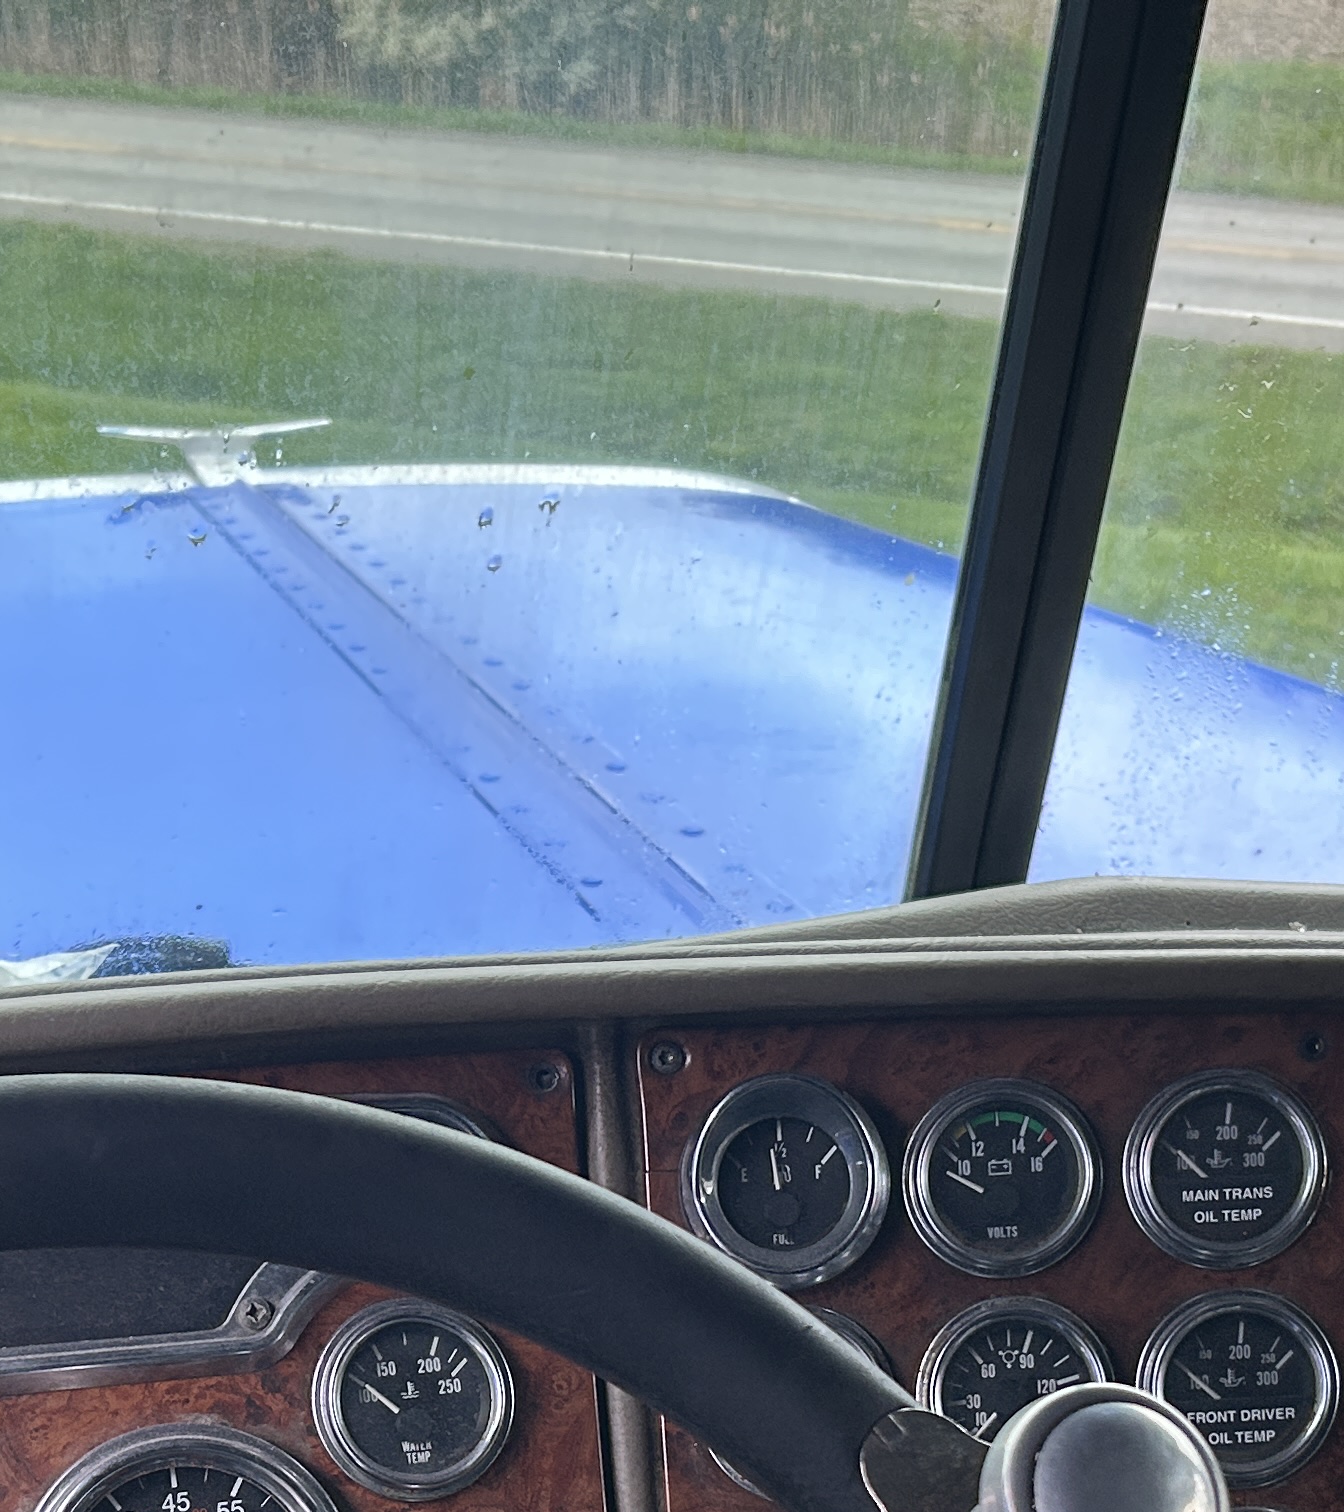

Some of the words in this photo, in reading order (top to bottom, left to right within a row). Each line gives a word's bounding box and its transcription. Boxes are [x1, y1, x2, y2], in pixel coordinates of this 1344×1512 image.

[1216, 1126, 1238, 1140] 200
[972, 1141, 984, 1157] 12
[1012, 1138, 1026, 1154] 14
[958, 1160, 971, 1176] 10
[1030, 1157, 1043, 1172] 16
[1242, 1152, 1265, 1168] 300
[741, 1168, 748, 1182] E
[816, 1164, 822, 1179] F
[1182, 1188, 1219, 1203] MAIN
[1222, 1186, 1273, 1200] TRANS
[1194, 1210, 1218, 1224] OIL
[1222, 1208, 1262, 1222] TEMP
[987, 1226, 1018, 1238] VOLTS
[1228, 1344, 1251, 1360] 200
[376, 1361, 396, 1377] 150
[417, 1357, 441, 1374] 200
[1019, 1354, 1034, 1368] 90
[981, 1364, 996, 1378] 60
[1256, 1370, 1278, 1386] 300
[438, 1378, 462, 1394] 250
[1037, 1379, 1056, 1394] 120
[966, 1394, 981, 1409] 30
[976, 1412, 987, 1426] 10
[1186, 1410, 1236, 1424] FRONT
[1240, 1407, 1295, 1422] DRIVER
[1208, 1432, 1232, 1445] OIL
[1235, 1430, 1276, 1444] TEMP
[406, 1450, 430, 1464] TEMP
[162, 1491, 191, 1512] 45
